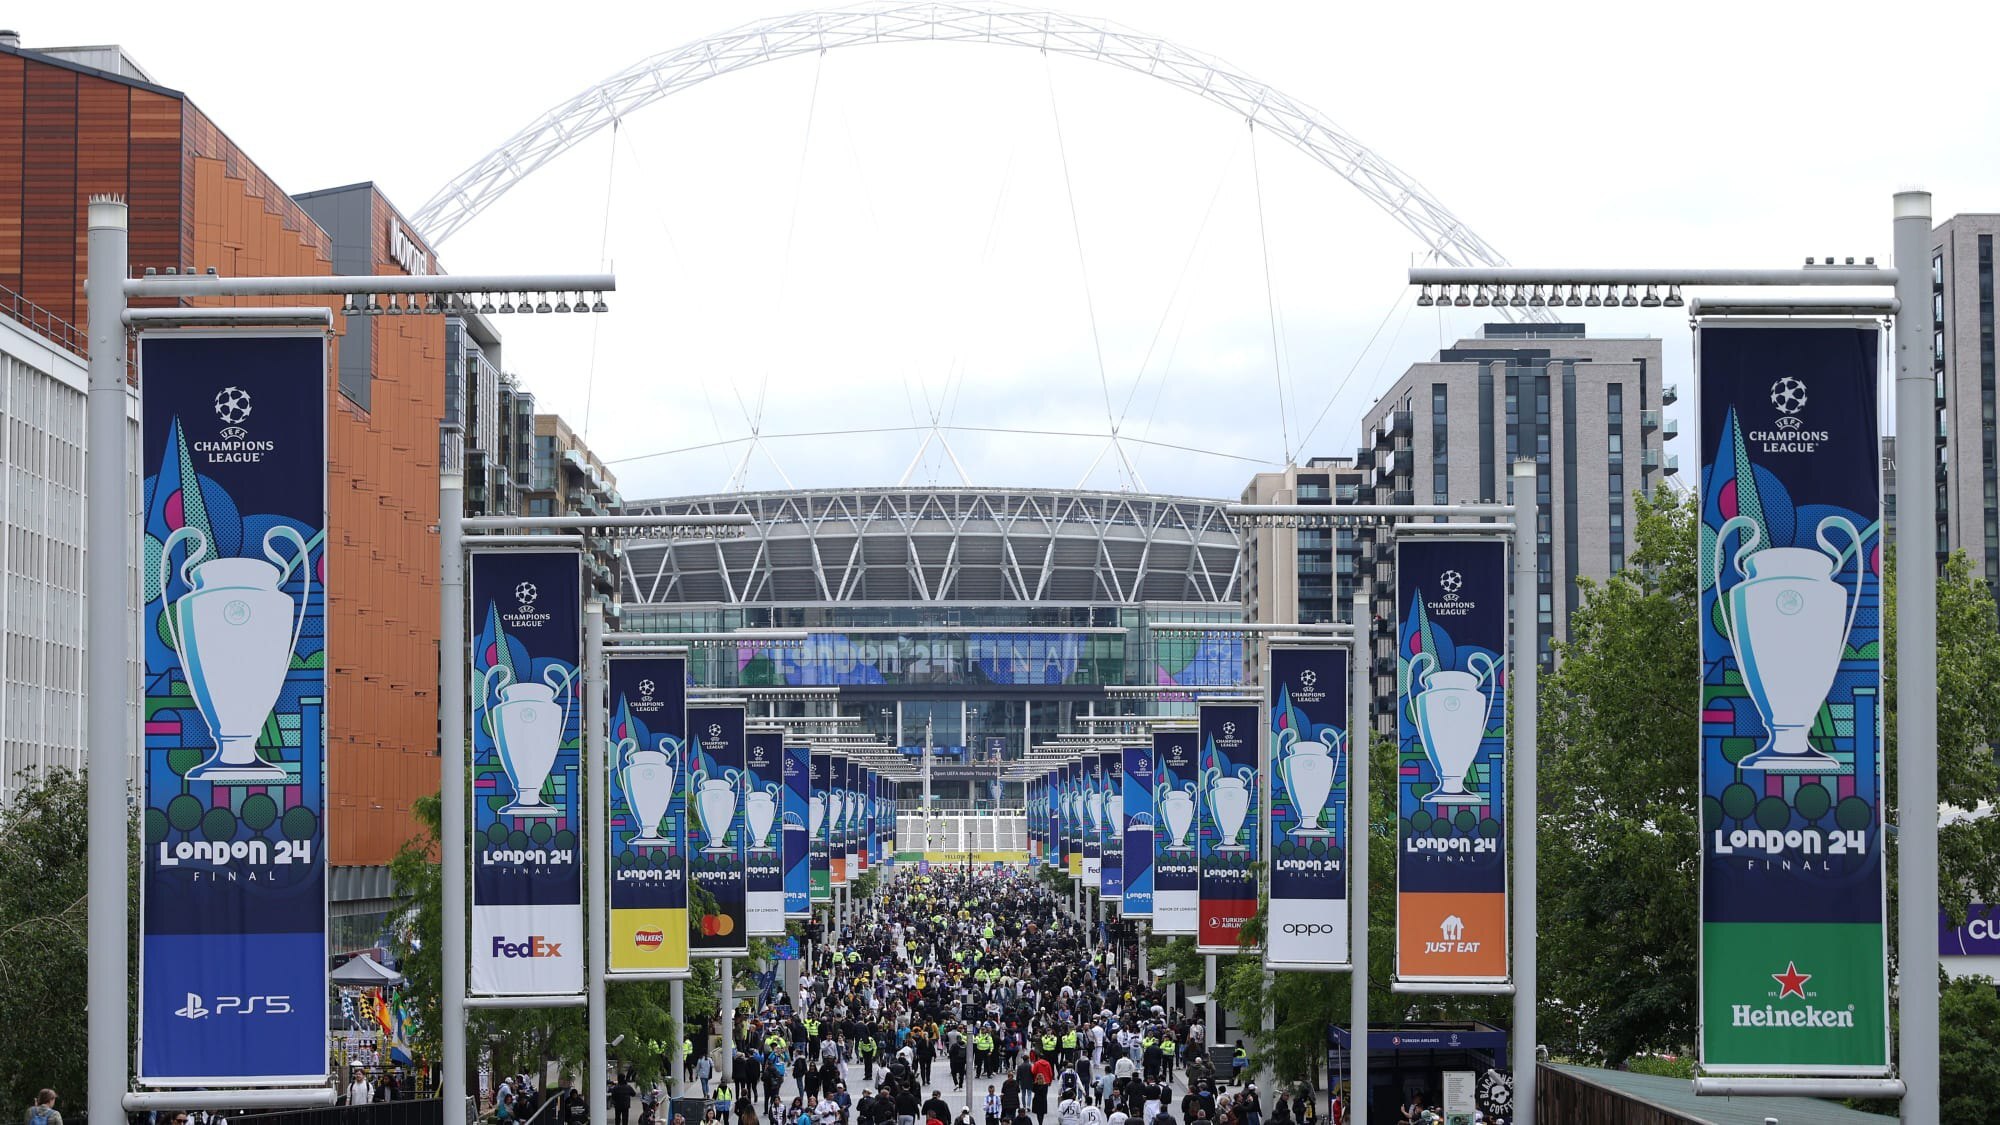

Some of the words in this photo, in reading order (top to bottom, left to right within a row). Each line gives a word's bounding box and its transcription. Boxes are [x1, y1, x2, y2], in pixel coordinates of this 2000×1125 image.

[1776, 418, 1801, 428] UEFA
[220, 428, 246, 439] UEFA
[1749, 431, 1829, 441] CHAMPIONS
[194, 441, 274, 451] CHAMPIONS
[1763, 442, 1814, 452] LEAGUE
[208, 452, 260, 462] LEAGUE
[910, 645, 953, 674] 24
[968, 646, 1088, 672] FINAL
[1474, 838, 1496, 852] 24
[1828, 830, 1866, 854] 24
[274, 840, 310, 864] 24
[550, 850, 572, 864] 24
[769, 866, 780, 874] 24
[1324, 860, 1340, 870] 24
[1748, 860, 1830, 870] FINAL
[194, 872, 276, 882] FINAL
[664, 869, 680, 880] 24
[728, 872, 740, 880] 24
[1282, 924, 1333, 936] oppo
[635, 934, 662, 942] WALKERS
[492, 936, 562, 958] FedEx
[1424, 942, 1454, 954] JUST
[1457, 942, 1480, 952] EAT
[216, 996, 290, 1014] PS5
[1732, 1004, 1854, 1028] Heineken
[1490, 1098, 1513, 1115] COFFE
[1088, 1112, 1096, 1122] 15
